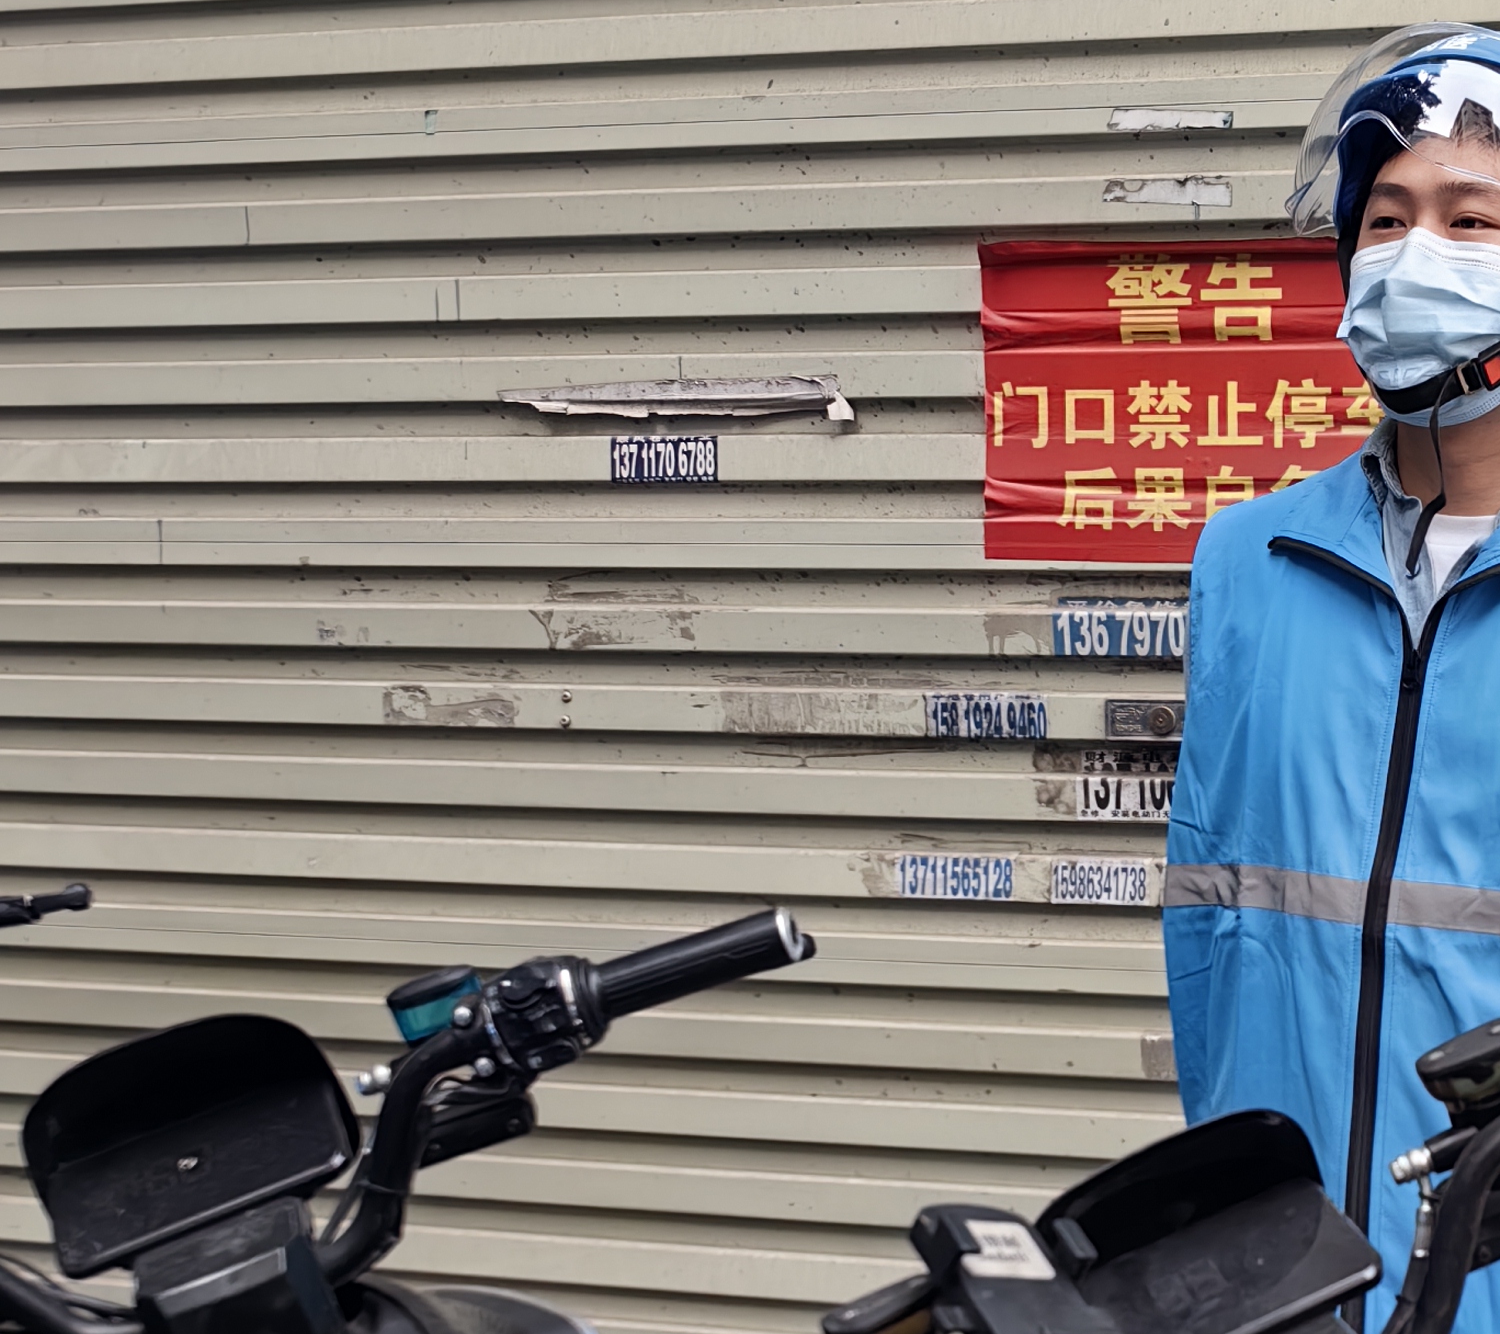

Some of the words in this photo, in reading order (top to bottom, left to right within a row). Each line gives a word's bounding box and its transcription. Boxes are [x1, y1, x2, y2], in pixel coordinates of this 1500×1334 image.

[1106, 254, 1283, 344] 警告
[992, 378, 1386, 451] 门口禁止停车
[613, 443, 638, 479] 137
[641, 442, 675, 478] 1170
[678, 440, 715, 476] 6788
[1055, 464, 1320, 532] 后果自
[1057, 610, 1109, 656] 136
[1115, 610, 1185, 657] 7970
[965, 701, 1003, 739] 1924
[1007, 701, 1047, 740] 9460
[900, 856, 1013, 899] 13711565128
[1053, 864, 1146, 901] 15986341738
